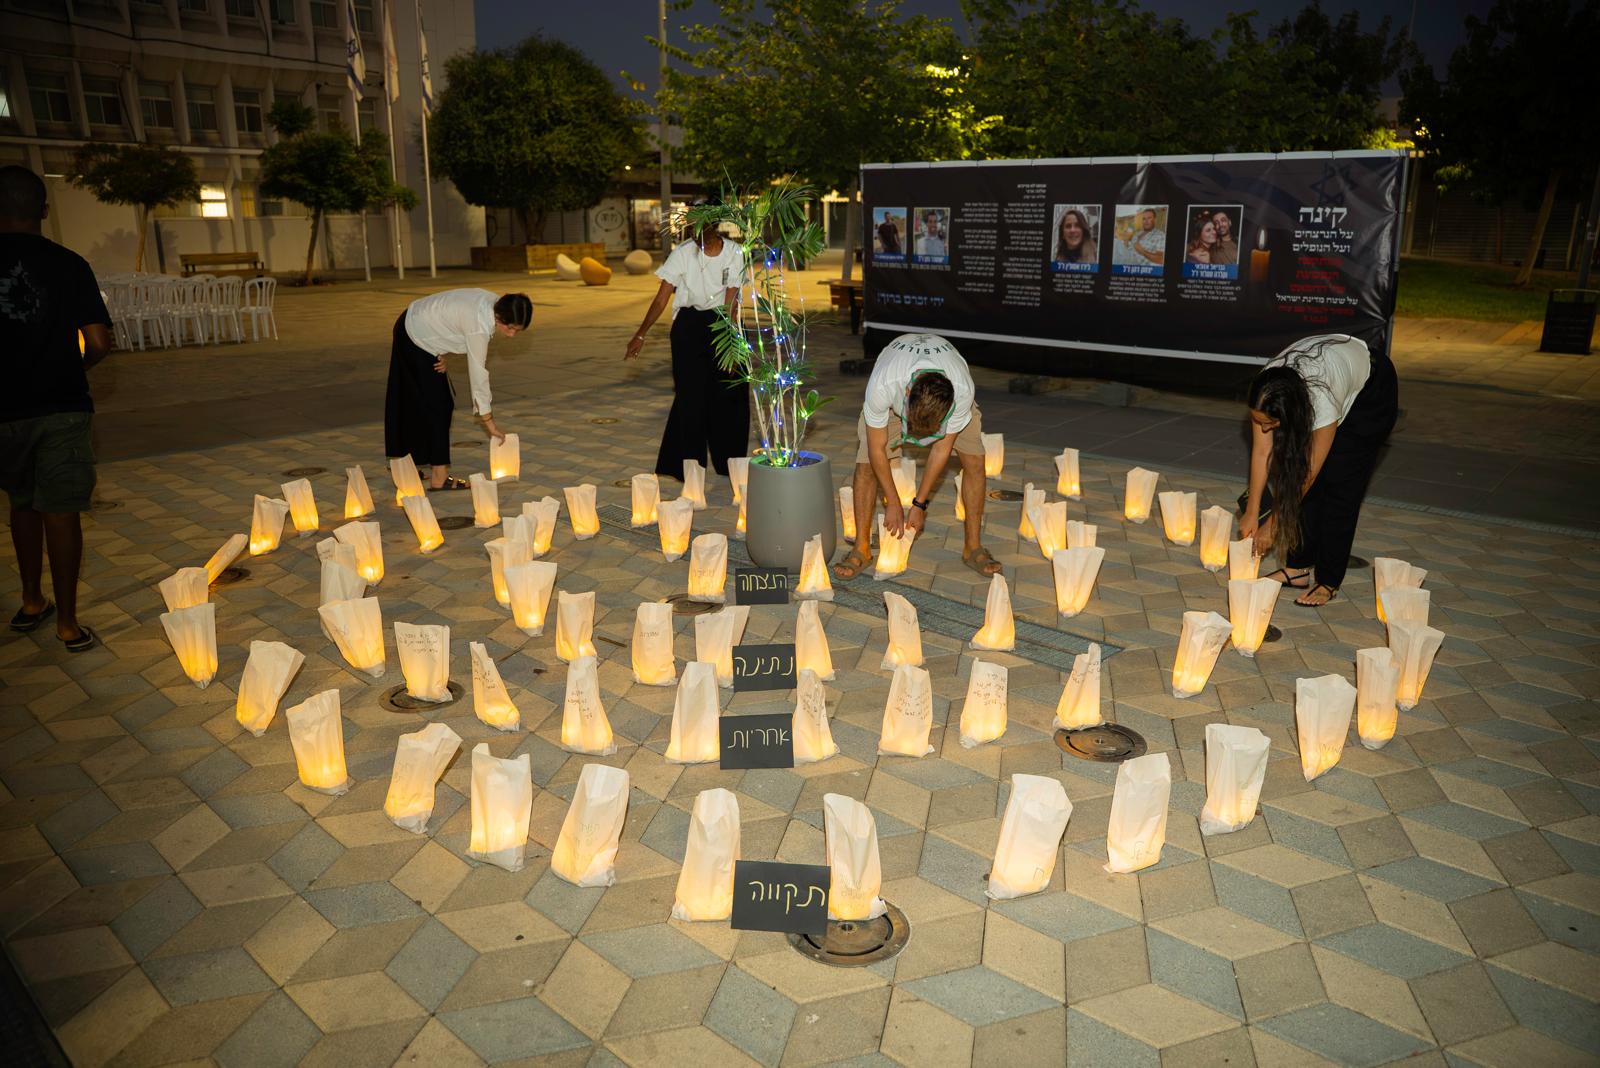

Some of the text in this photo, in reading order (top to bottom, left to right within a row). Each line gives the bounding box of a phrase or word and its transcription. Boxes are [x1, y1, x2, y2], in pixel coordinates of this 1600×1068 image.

[1299, 207, 1347, 229] קינה
[1294, 228, 1354, 239] על הנרצחים
[1292, 241, 1350, 253] ועל הנופלים
[903, 295, 928, 305] זכרם
[930, 297, 944, 306] יהי
[1275, 292, 1301, 303] ישראל
[1302, 296, 1325, 304] מדינת
[1346, 295, 1358, 305] על
[738, 573, 787, 592] הנצחה
[734, 656, 794, 677] נתינה
[727, 728, 790, 749] אחריות
[748, 880, 826, 915] תקווה
